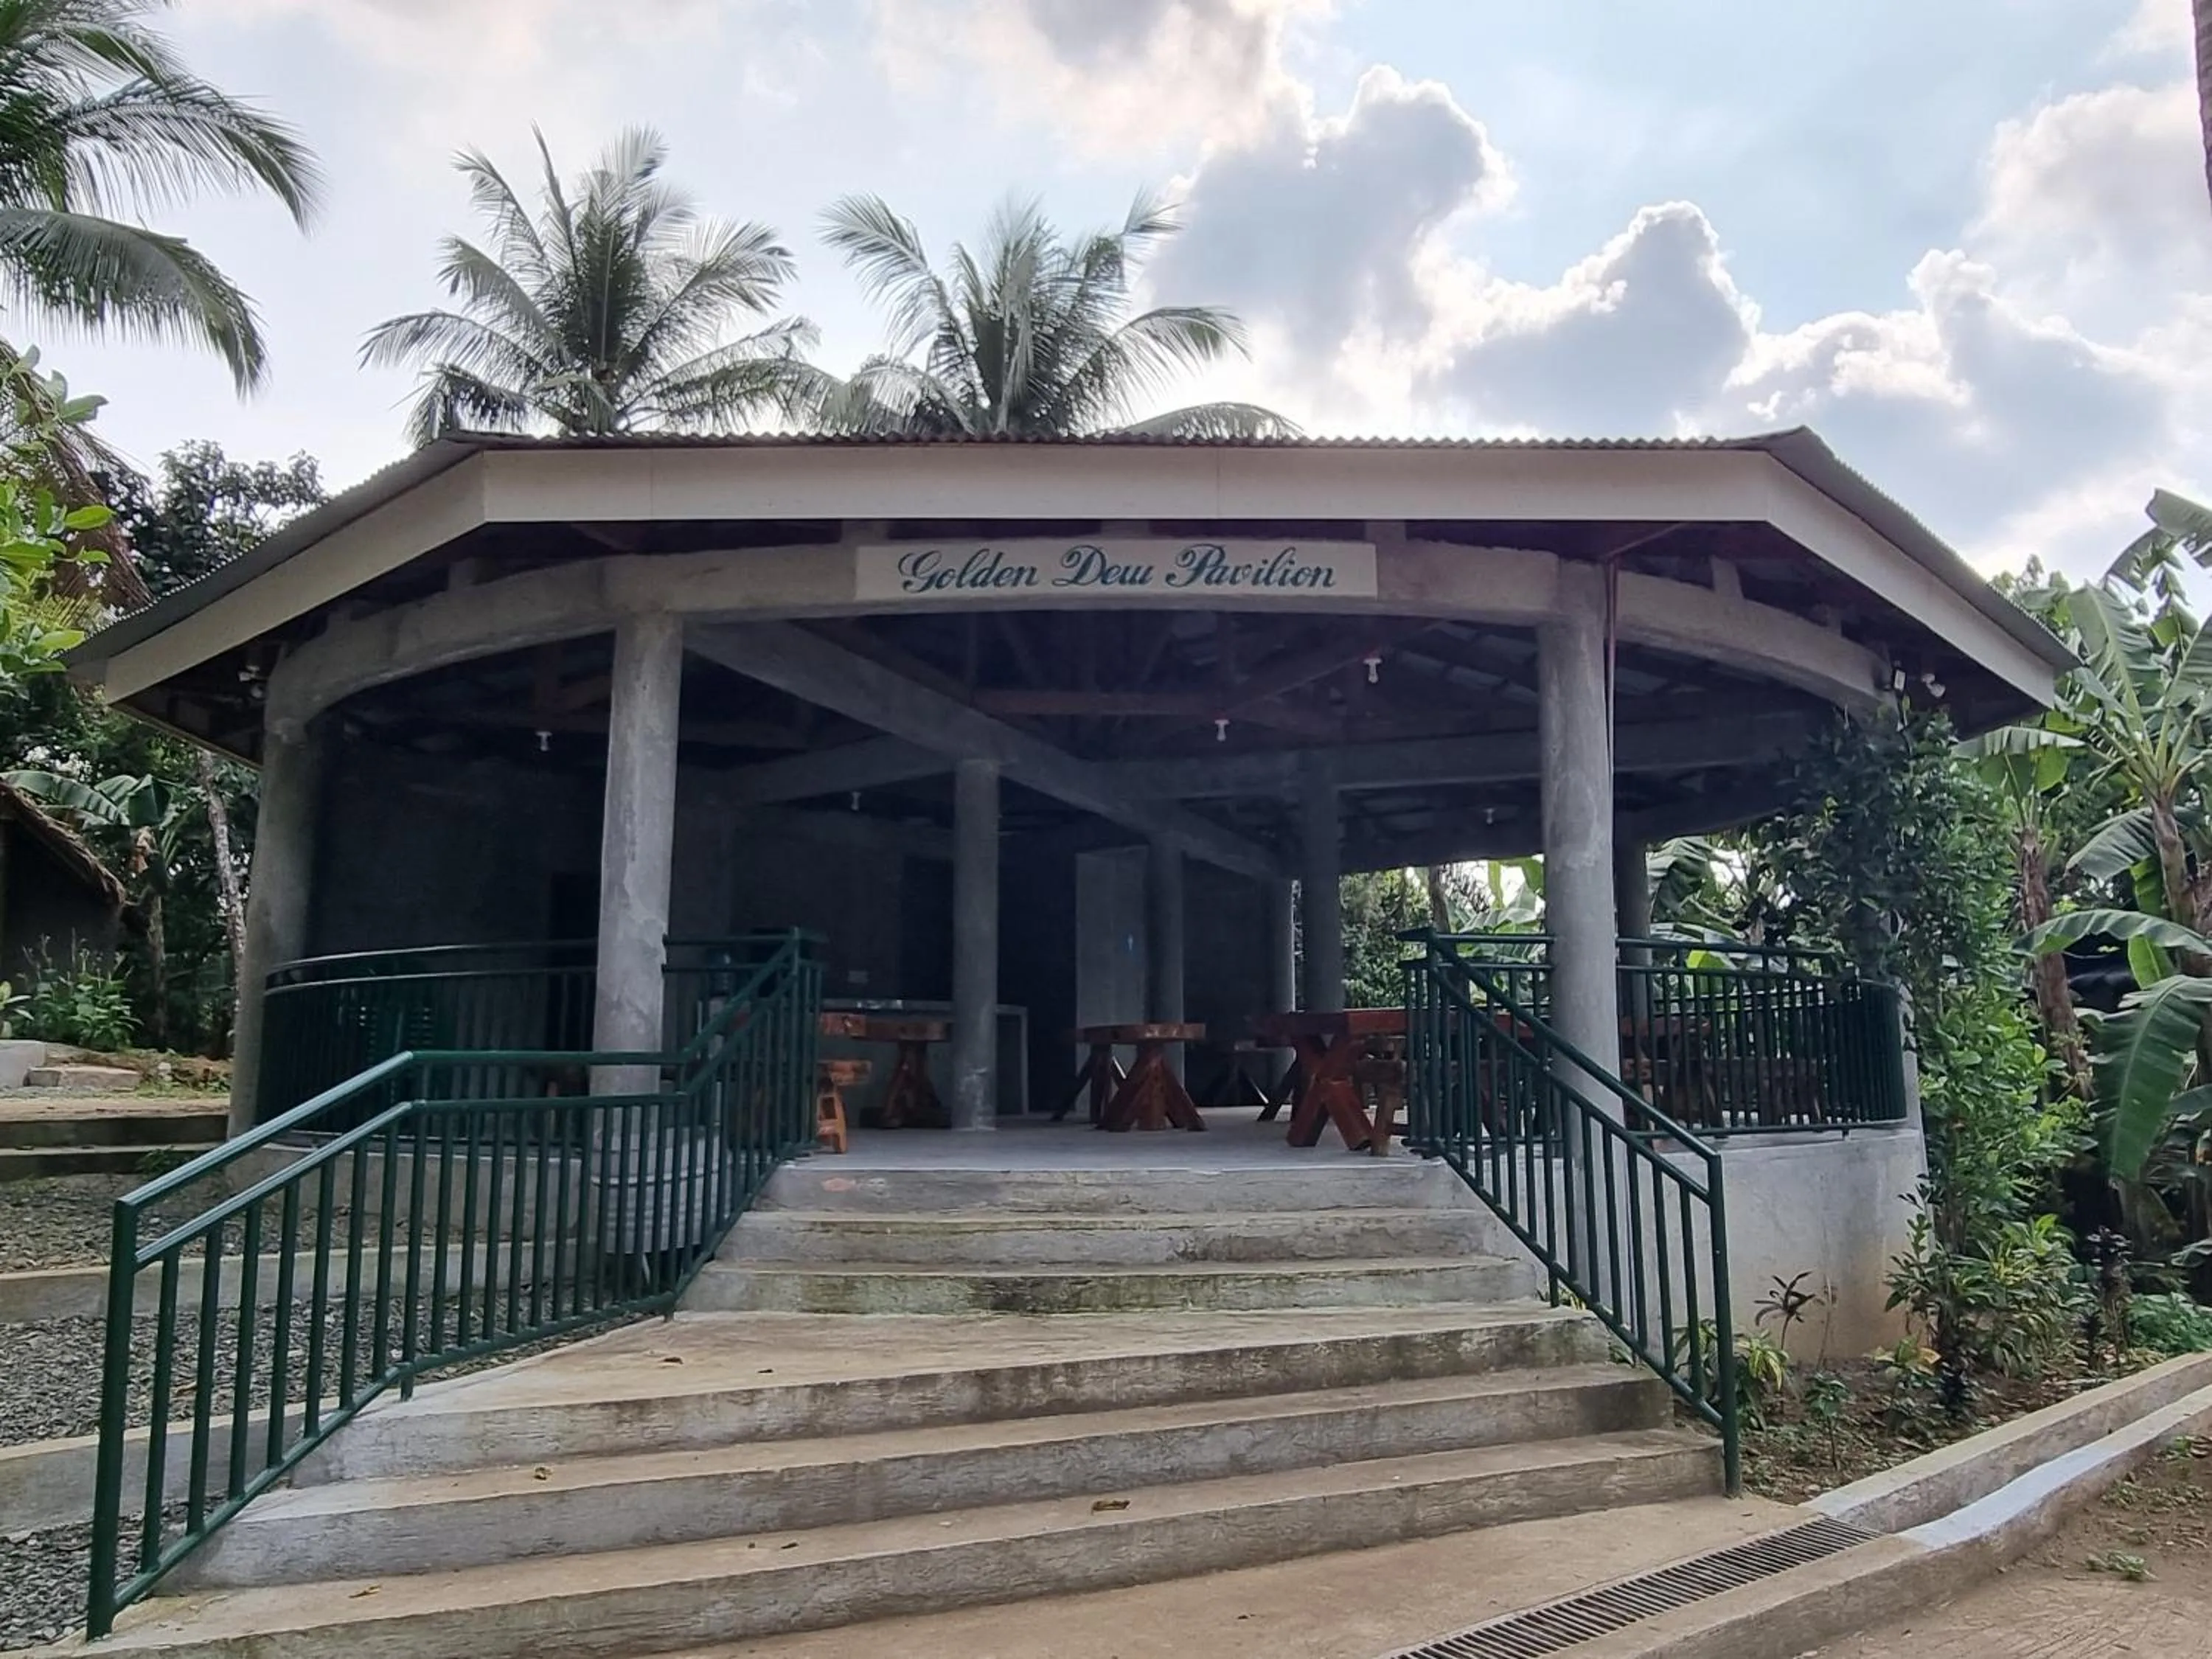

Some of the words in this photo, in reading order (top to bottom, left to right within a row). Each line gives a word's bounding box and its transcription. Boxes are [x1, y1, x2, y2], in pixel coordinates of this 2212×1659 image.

[898, 548, 1039, 593] Golden
[1052, 545, 1154, 587] Dew
[1165, 543, 1335, 588] Pavilion
